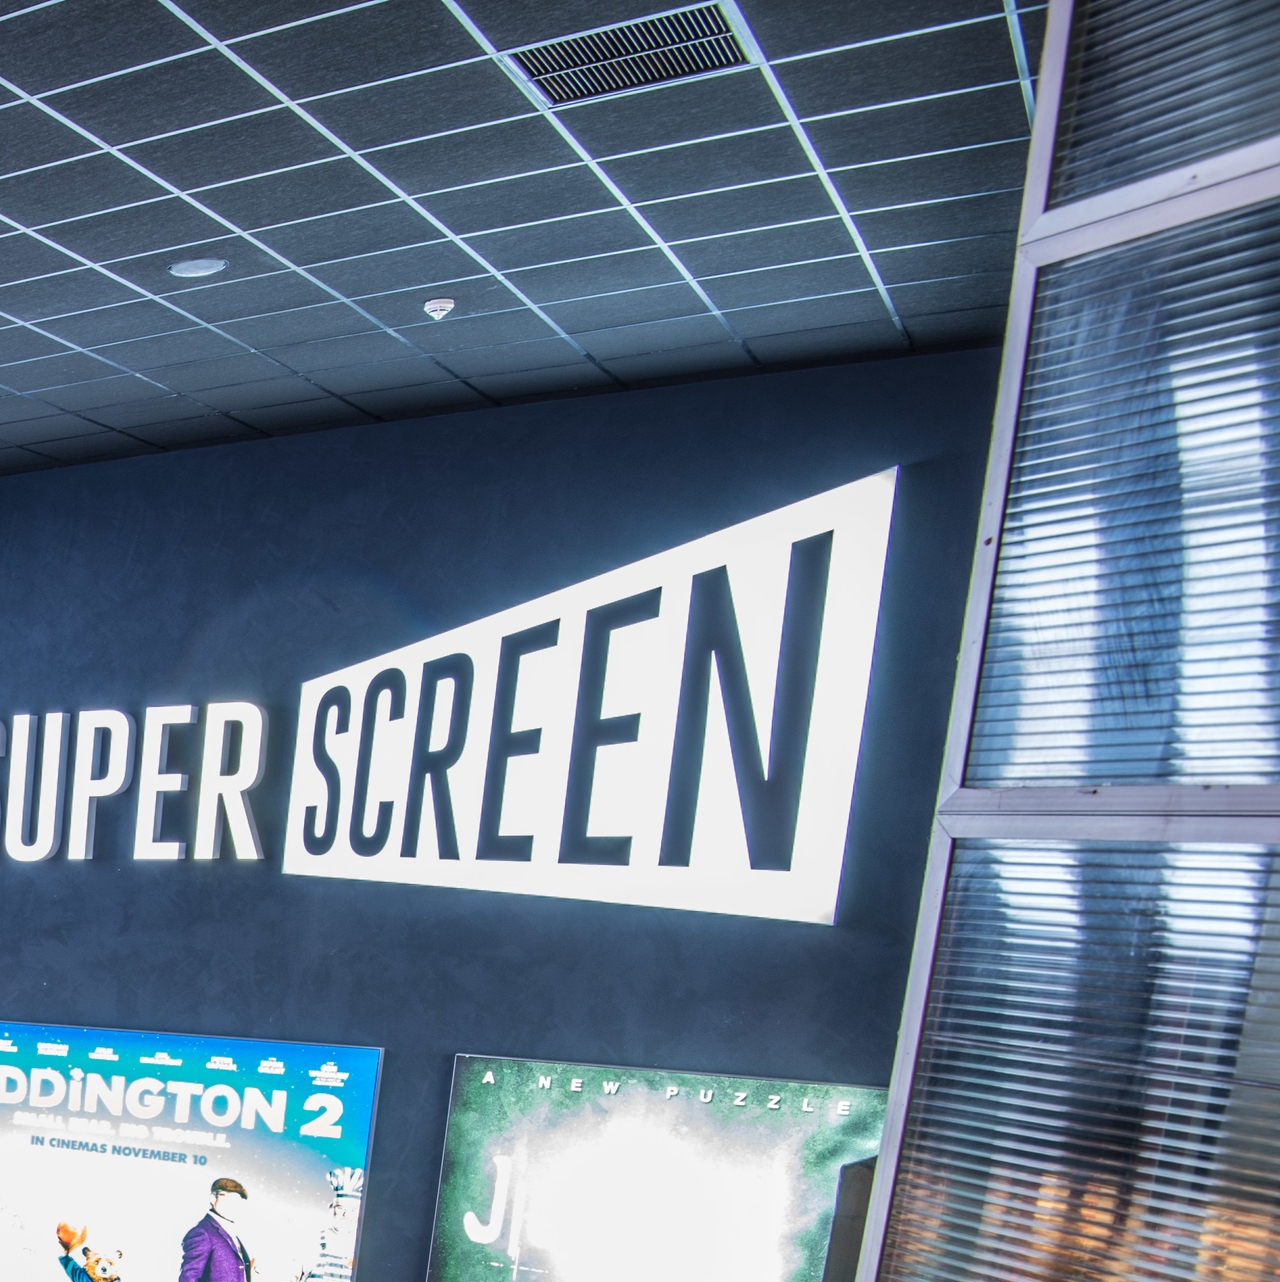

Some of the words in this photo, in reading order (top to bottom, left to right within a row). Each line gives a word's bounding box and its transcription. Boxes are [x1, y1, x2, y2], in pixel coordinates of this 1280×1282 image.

[302, 529, 835, 872] SCREEN
[299, 1092, 344, 1139] 2
[482, 1071, 496, 1085] A
[538, 1075, 621, 1095] NEW
[665, 1086, 851, 1117] PUZZLE
[30, 1135, 45, 1147] IN
[49, 1137, 108, 1154] CINEMAS
[111, 1145, 188, 1164] NOVEMBER
[192, 1154, 208, 1167] 10
